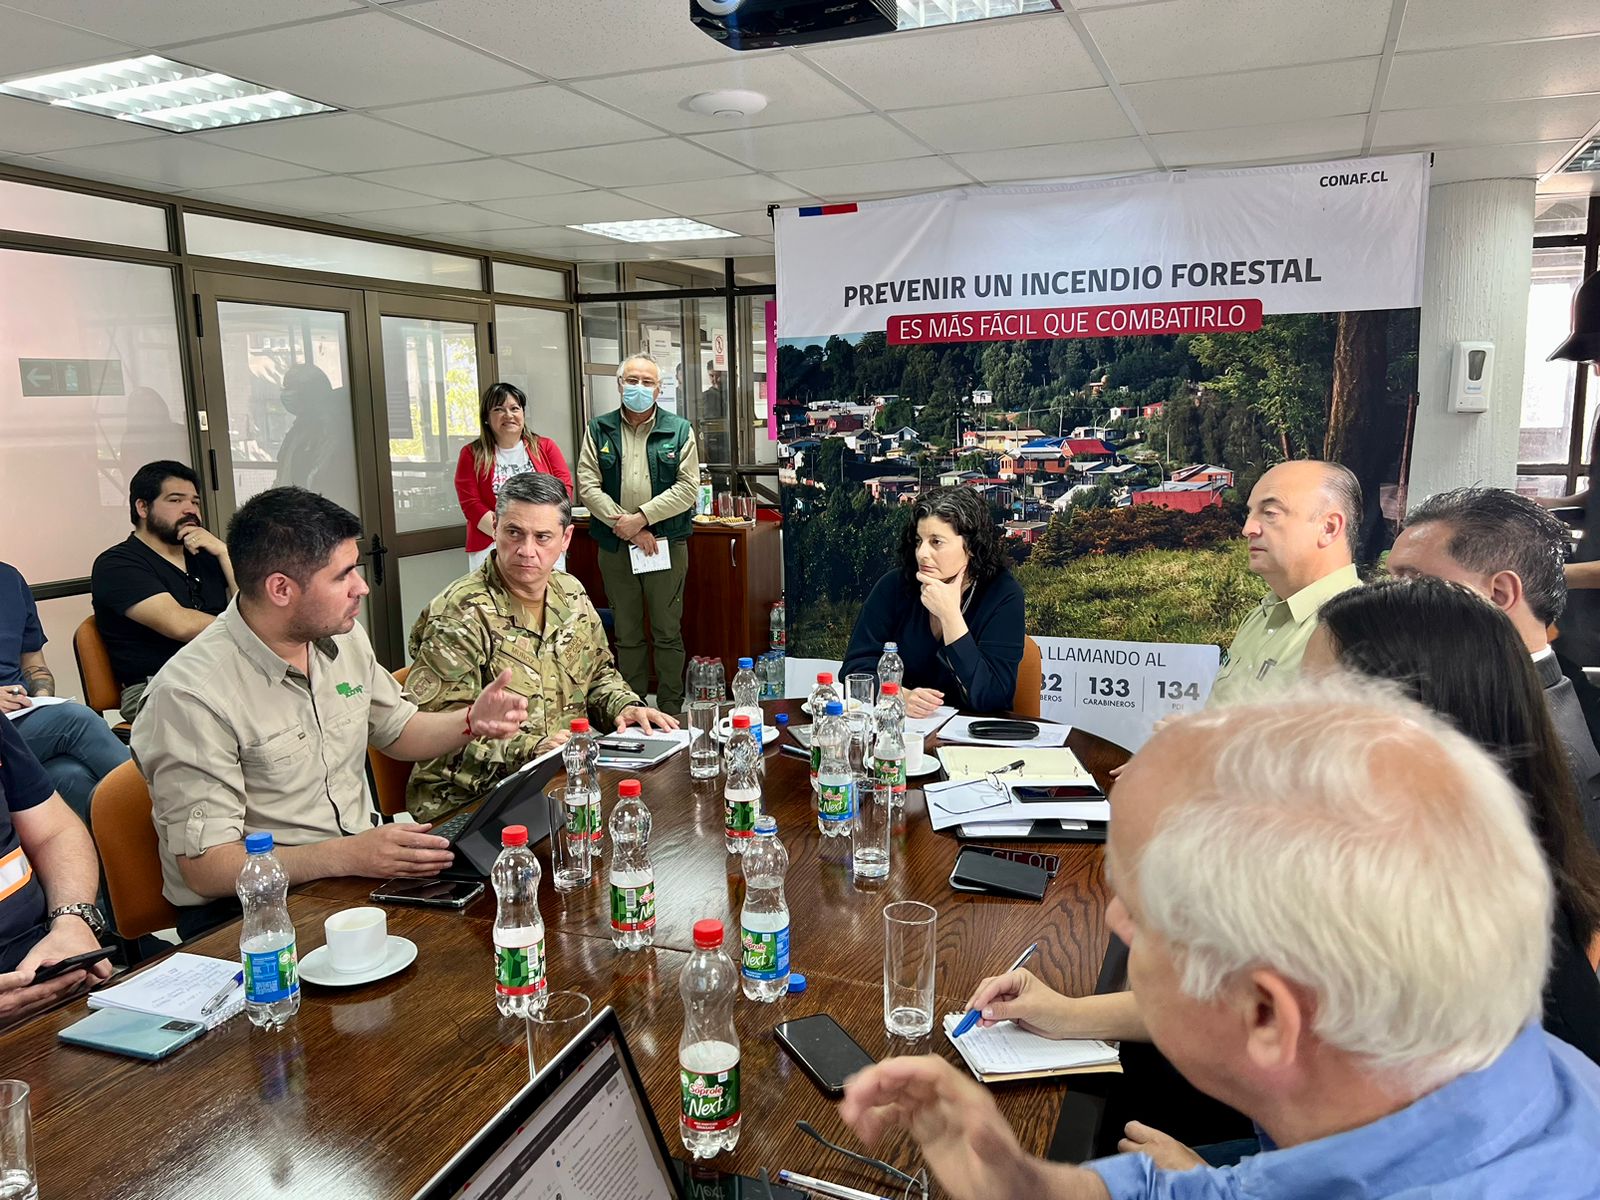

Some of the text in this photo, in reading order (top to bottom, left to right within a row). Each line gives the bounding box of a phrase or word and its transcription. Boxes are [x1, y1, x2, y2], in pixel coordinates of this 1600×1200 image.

[1319, 171, 1388, 187] CONAF.CL
[844, 257, 1322, 307] PREVENIR UN INCENDIO FORESTAL
[899, 304, 1246, 340] ES MÁS FÁCIL QUE COMBATIRLO
[1048, 646, 1140, 666] LLAMANDO
[1145, 652, 1166, 667] AL
[1088, 676, 1130, 698] 133
[1157, 681, 1200, 701] 134
[1040, 694, 1062, 703] BEROS
[1082, 697, 1136, 708] CARABINEROS
[742, 950, 768, 967] Next
[688, 1096, 724, 1117] Next
